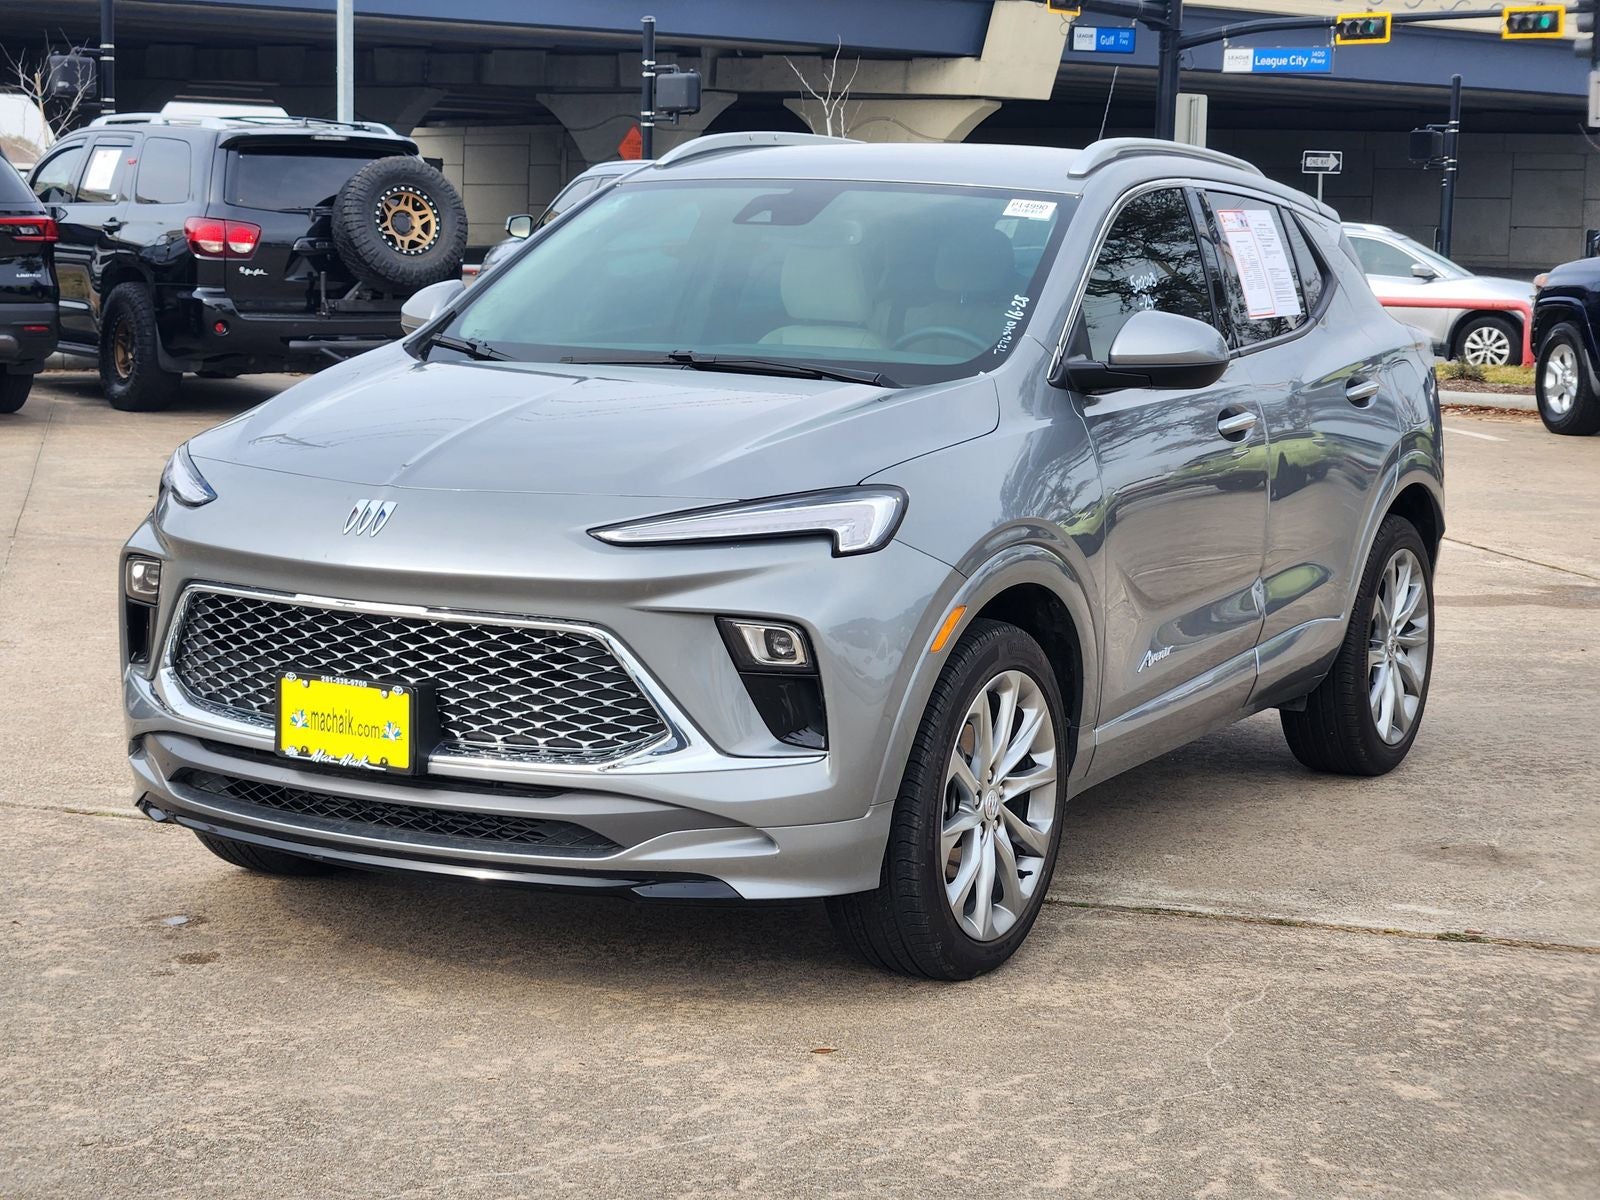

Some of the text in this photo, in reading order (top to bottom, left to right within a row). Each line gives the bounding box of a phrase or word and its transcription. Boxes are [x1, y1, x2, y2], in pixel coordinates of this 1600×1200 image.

[1100, 35, 1115, 46] Gulf
[1254, 55, 1309, 69] League City
[1137, 645, 1174, 673] Avenir
[310, 708, 380, 739] machaik.com
